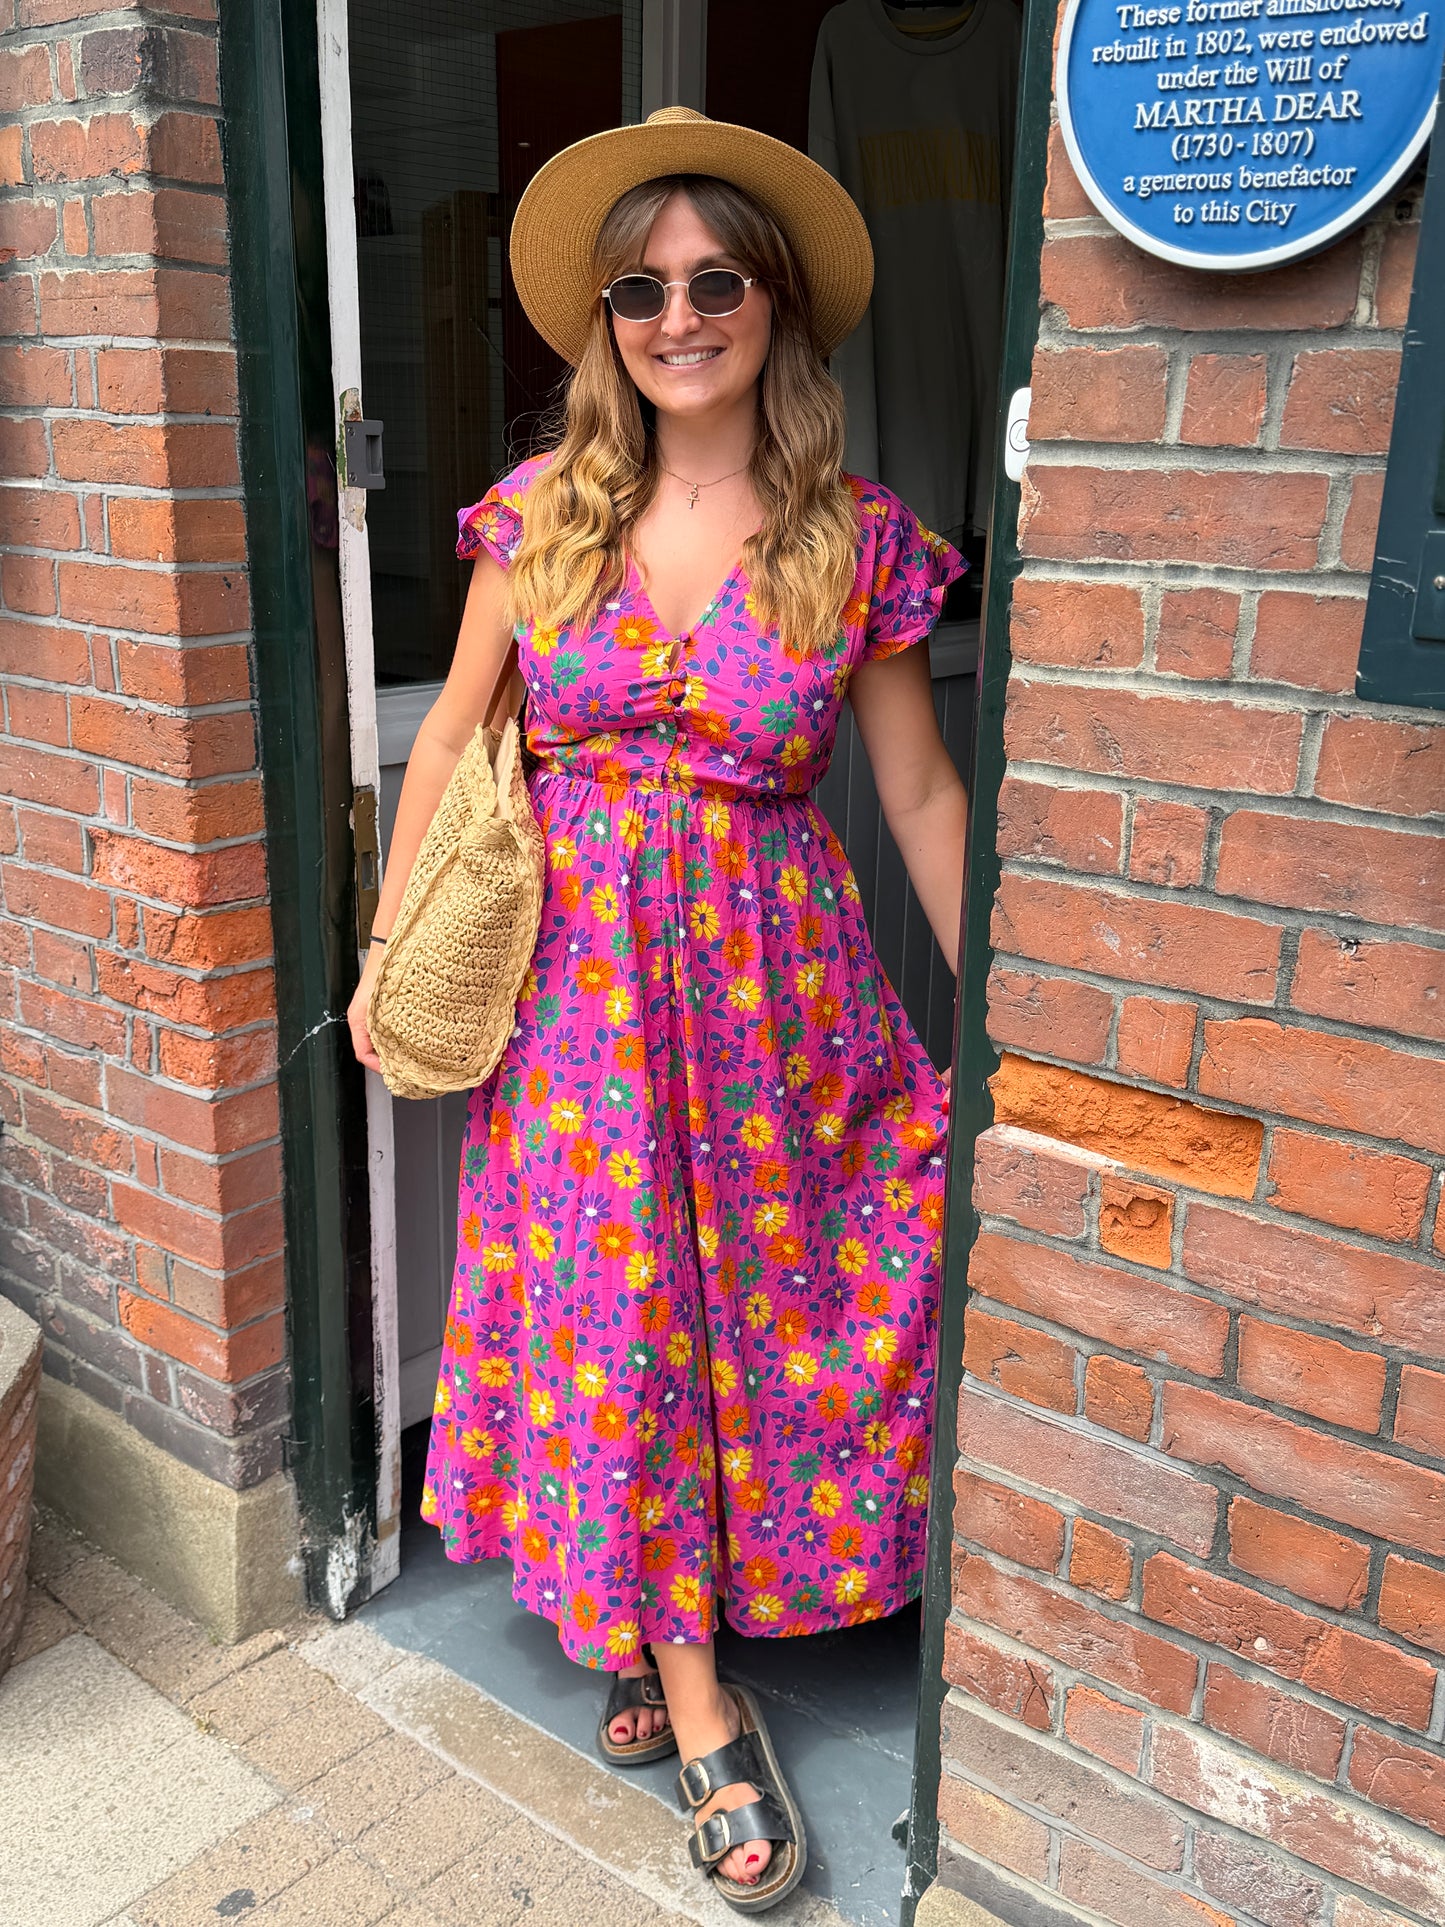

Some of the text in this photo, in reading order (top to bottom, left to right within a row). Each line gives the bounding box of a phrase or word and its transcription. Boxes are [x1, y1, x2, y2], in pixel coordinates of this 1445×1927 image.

[1116, 4, 1181, 28] These
[1185, 0, 1264, 22] former
[1092, 12, 1429, 63] rebuilt in 1802, were endowed
[1156, 54, 1348, 90] under the Will of
[1133, 89, 1362, 129] MARTHA DEAR
[1123, 163, 1356, 198] a generous benefactor
[1173, 199, 1296, 226] to this City
